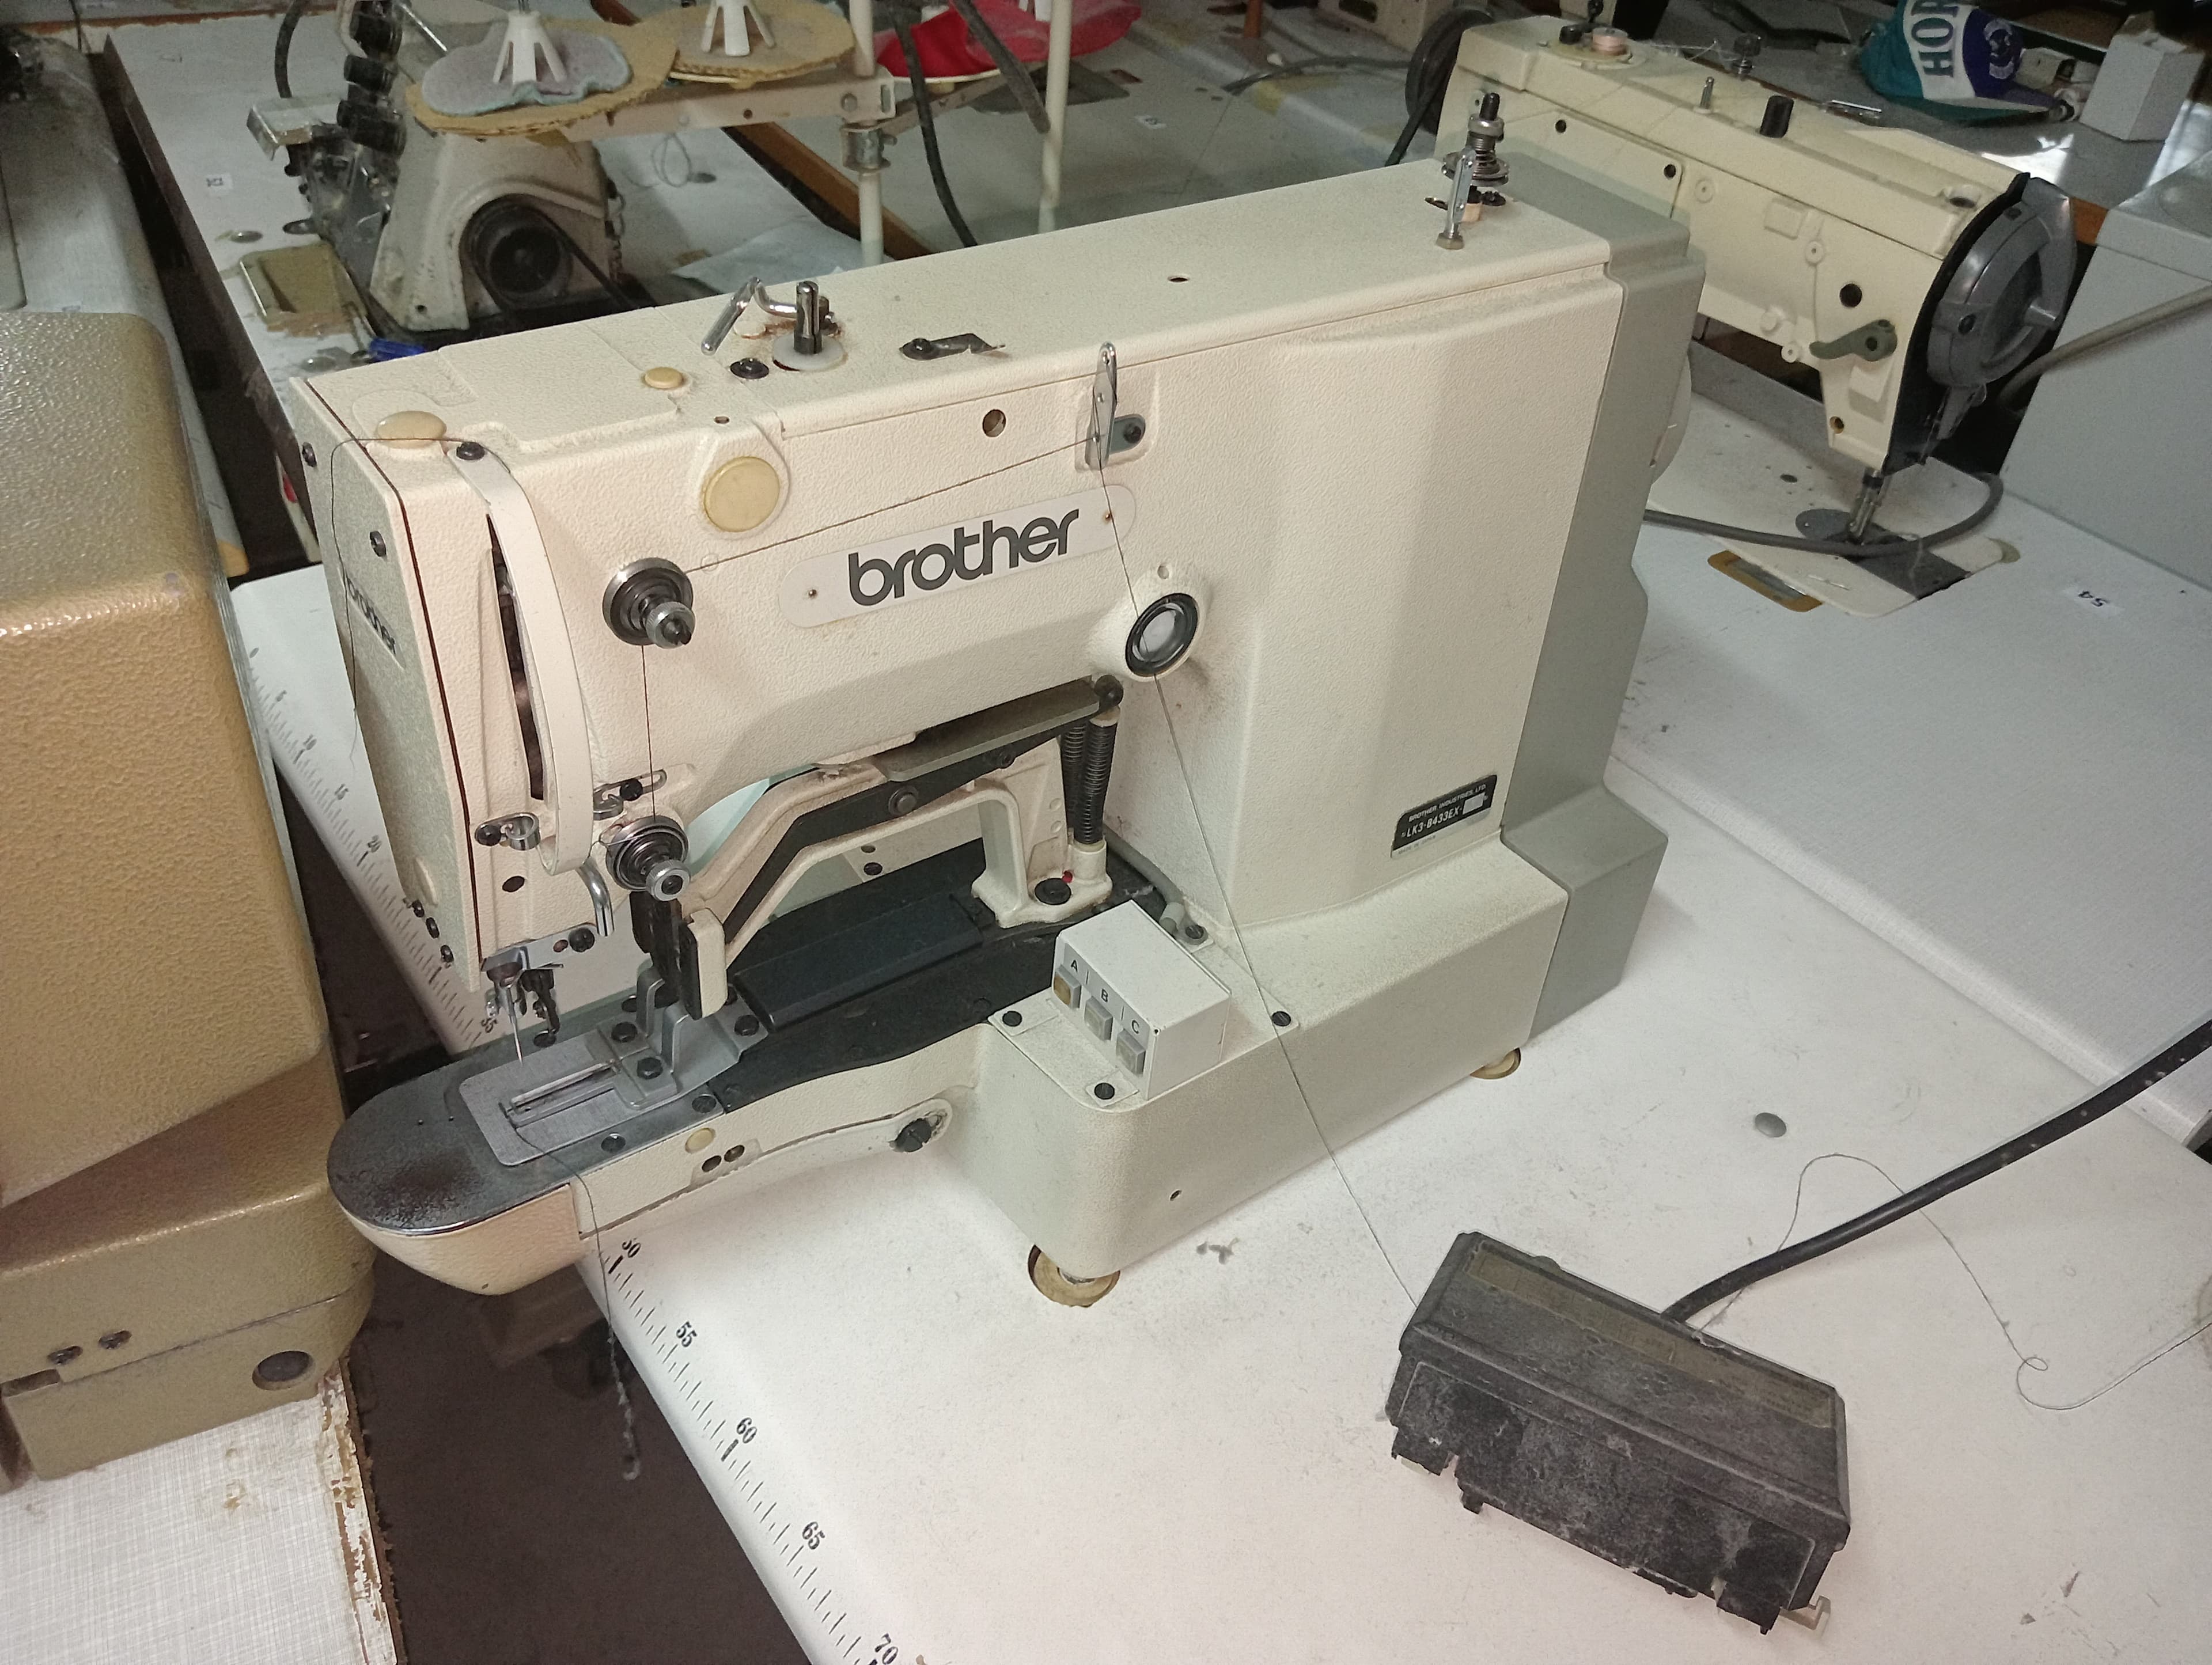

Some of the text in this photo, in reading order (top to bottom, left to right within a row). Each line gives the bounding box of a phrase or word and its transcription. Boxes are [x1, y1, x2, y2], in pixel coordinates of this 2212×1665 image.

[849, 509, 1079, 606] brother
[1409, 806, 1437, 822] BROTHER
[1070, 959, 1078, 972] A
[1101, 989, 1108, 1002] B
[1131, 1019, 1139, 1034] C
[676, 1321, 697, 1347] 55
[737, 1417, 757, 1444] 60
[802, 1522, 825, 1550] 65
[875, 1633, 899, 1664] 70
